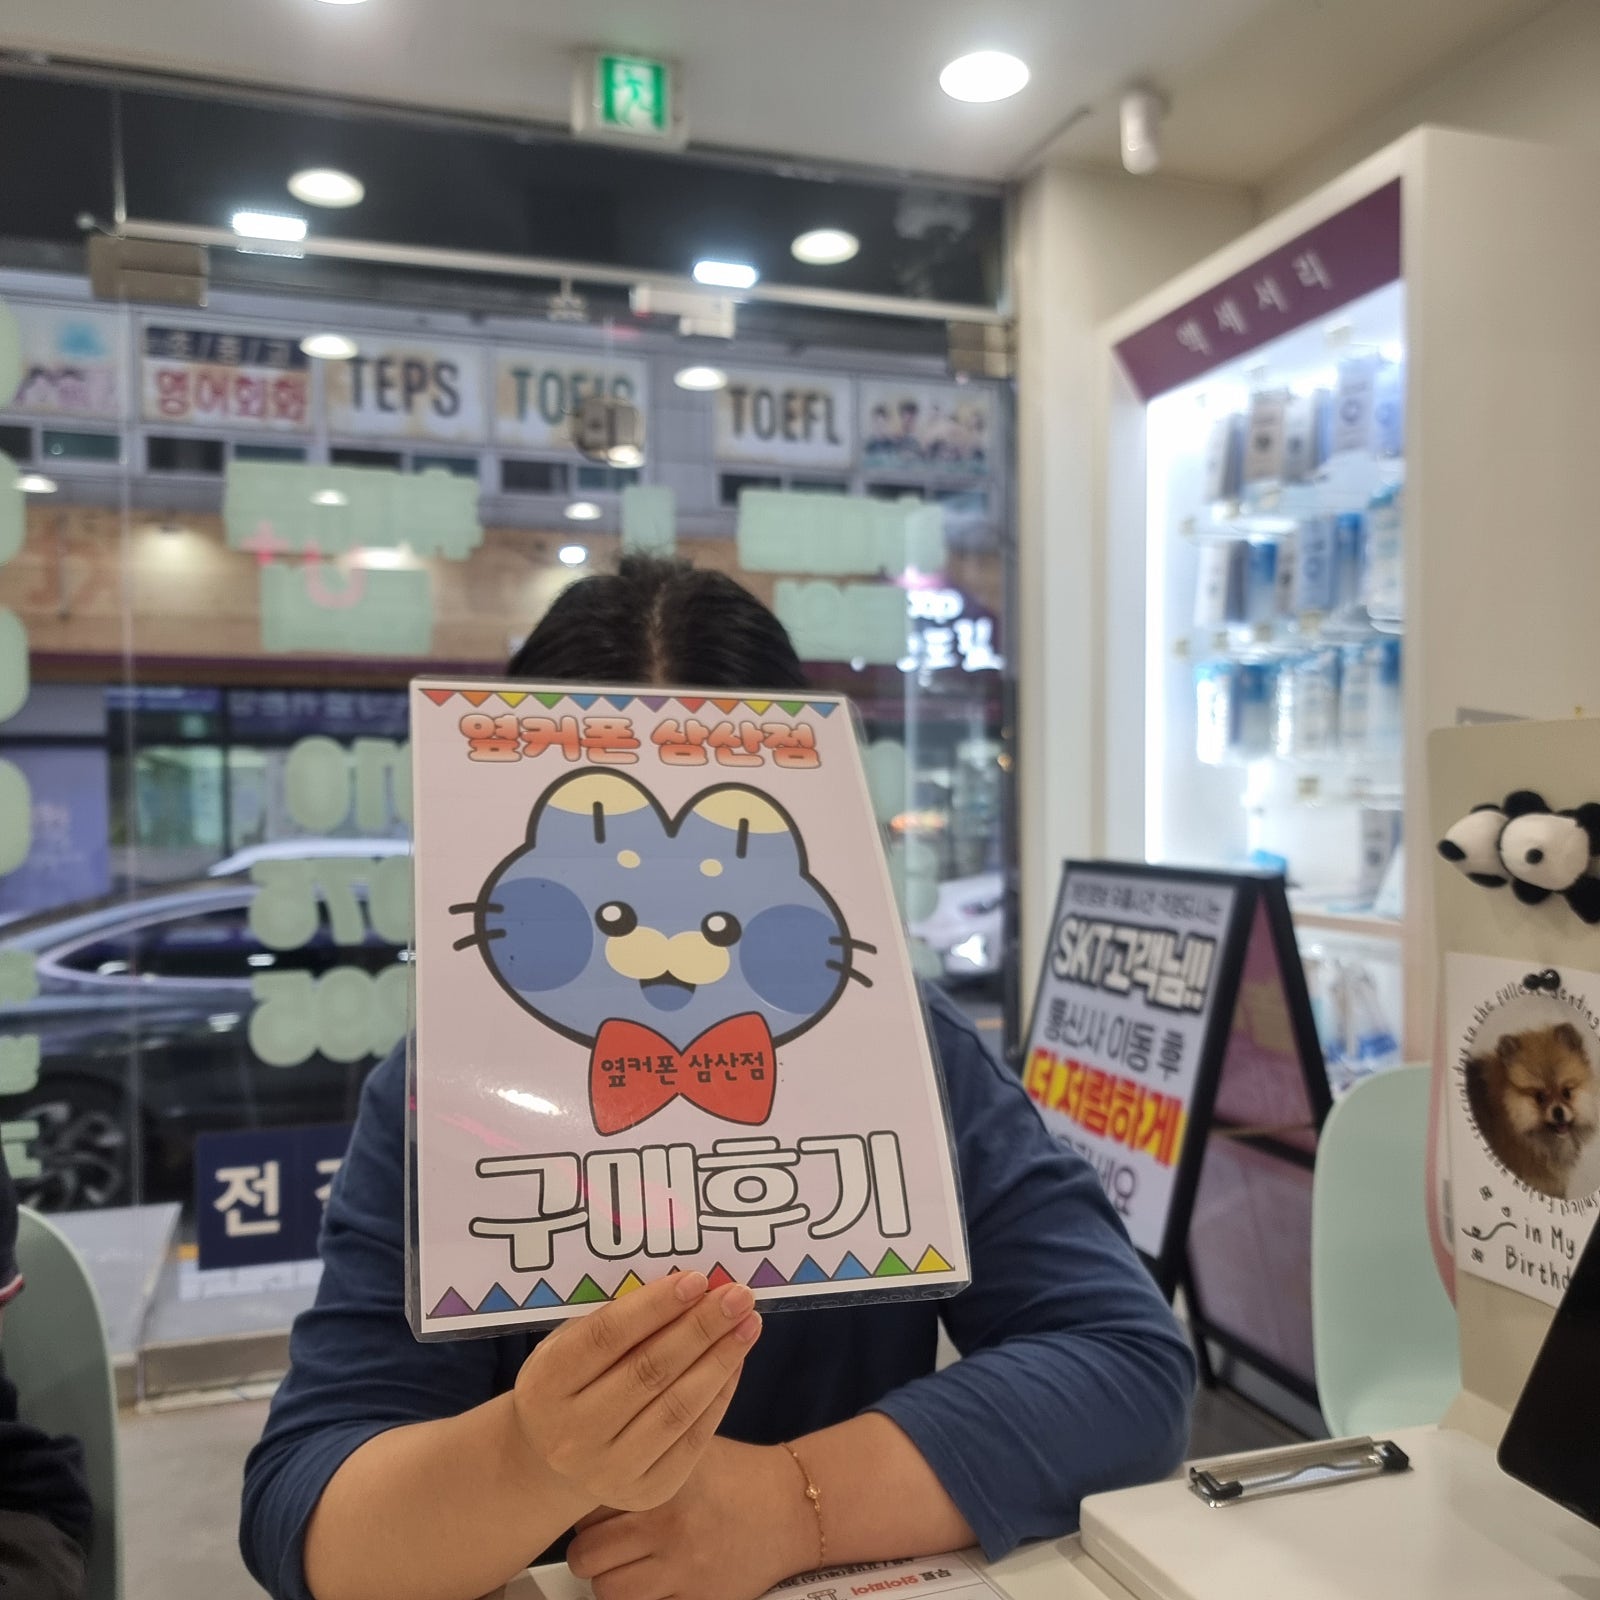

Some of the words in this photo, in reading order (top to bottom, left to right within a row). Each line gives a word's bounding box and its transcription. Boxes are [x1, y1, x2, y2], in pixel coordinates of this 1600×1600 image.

[347, 355, 462, 418] TEPS
[728, 384, 843, 445] TOEFL
[458, 713, 641, 765] 옆커폰
[650, 719, 822, 769] 삼산점
[1044, 997, 1106, 1054] 통신사
[1107, 1014, 1156, 1073] 이동
[601, 1055, 679, 1088] 옆커폰
[687, 1051, 765, 1084] 삼산점
[468, 1129, 912, 1273] 구매후기
[1524, 1216, 1542, 1245] in
[1550, 1224, 1575, 1260] My
